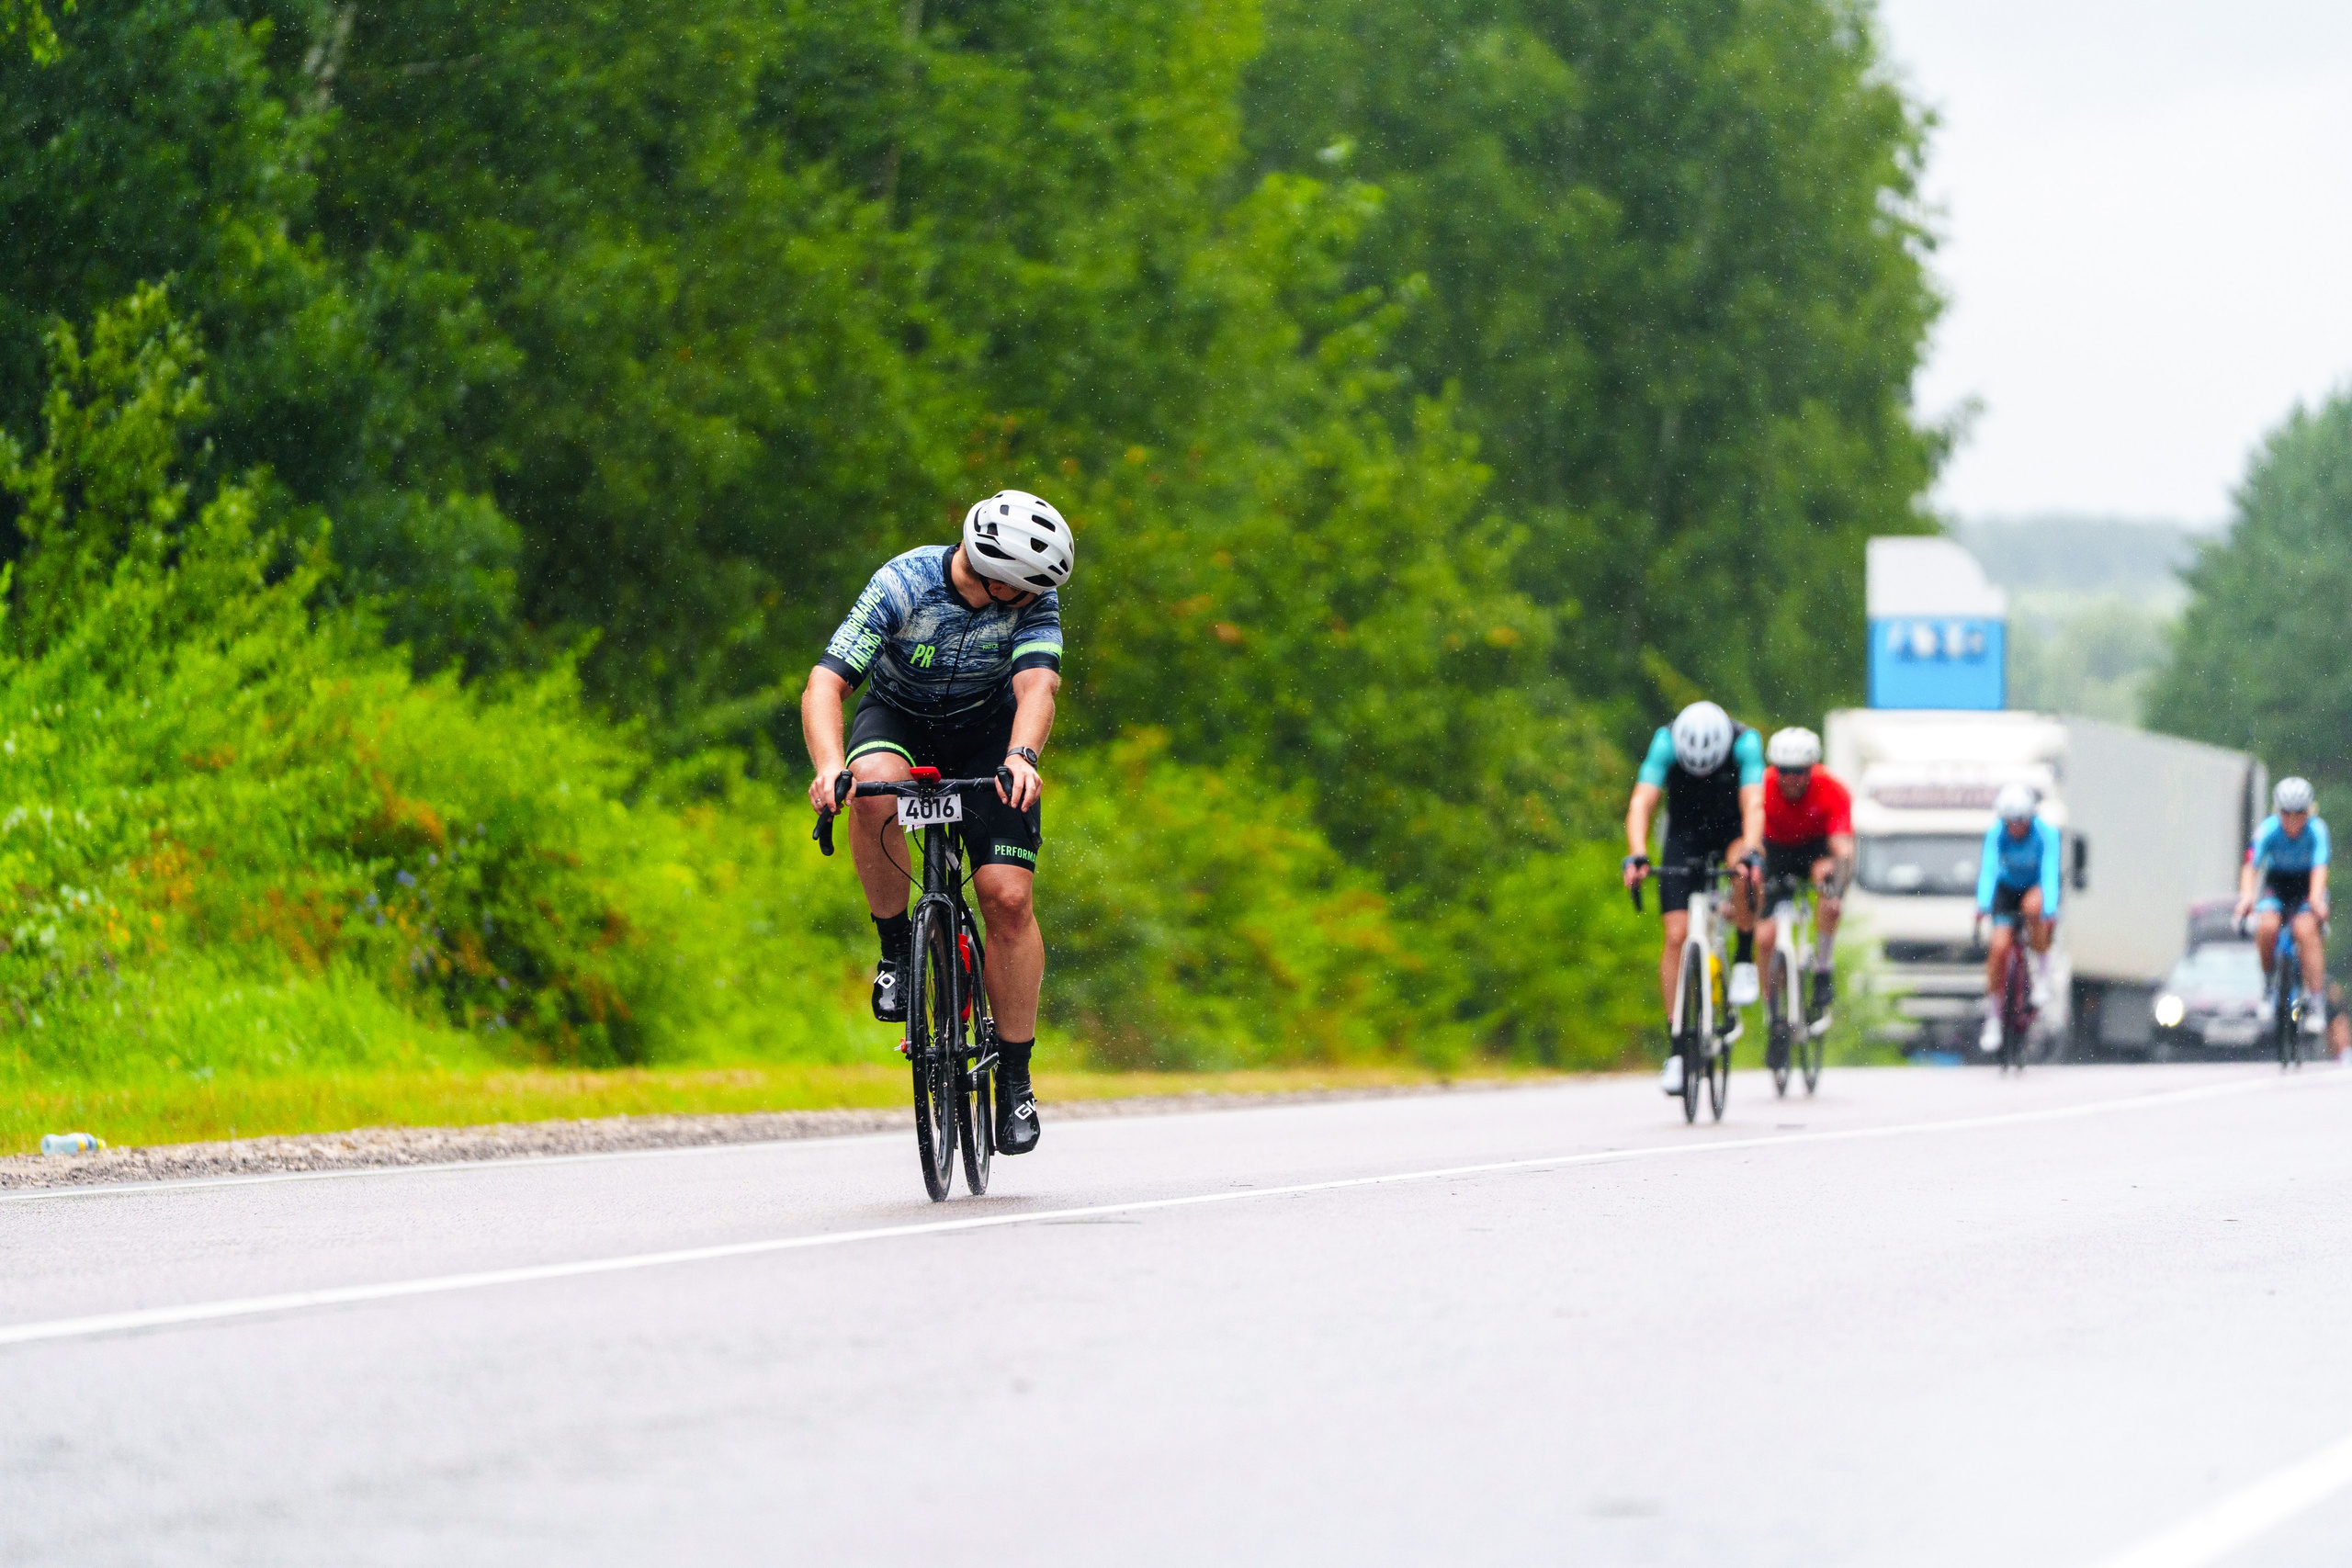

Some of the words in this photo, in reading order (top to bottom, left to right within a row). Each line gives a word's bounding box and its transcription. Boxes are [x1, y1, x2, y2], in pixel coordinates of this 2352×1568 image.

[828, 583, 885, 660] PERFORMANCE
[845, 627, 882, 673] RACERS
[910, 643, 935, 668] PR
[905, 797, 955, 819] 4016
